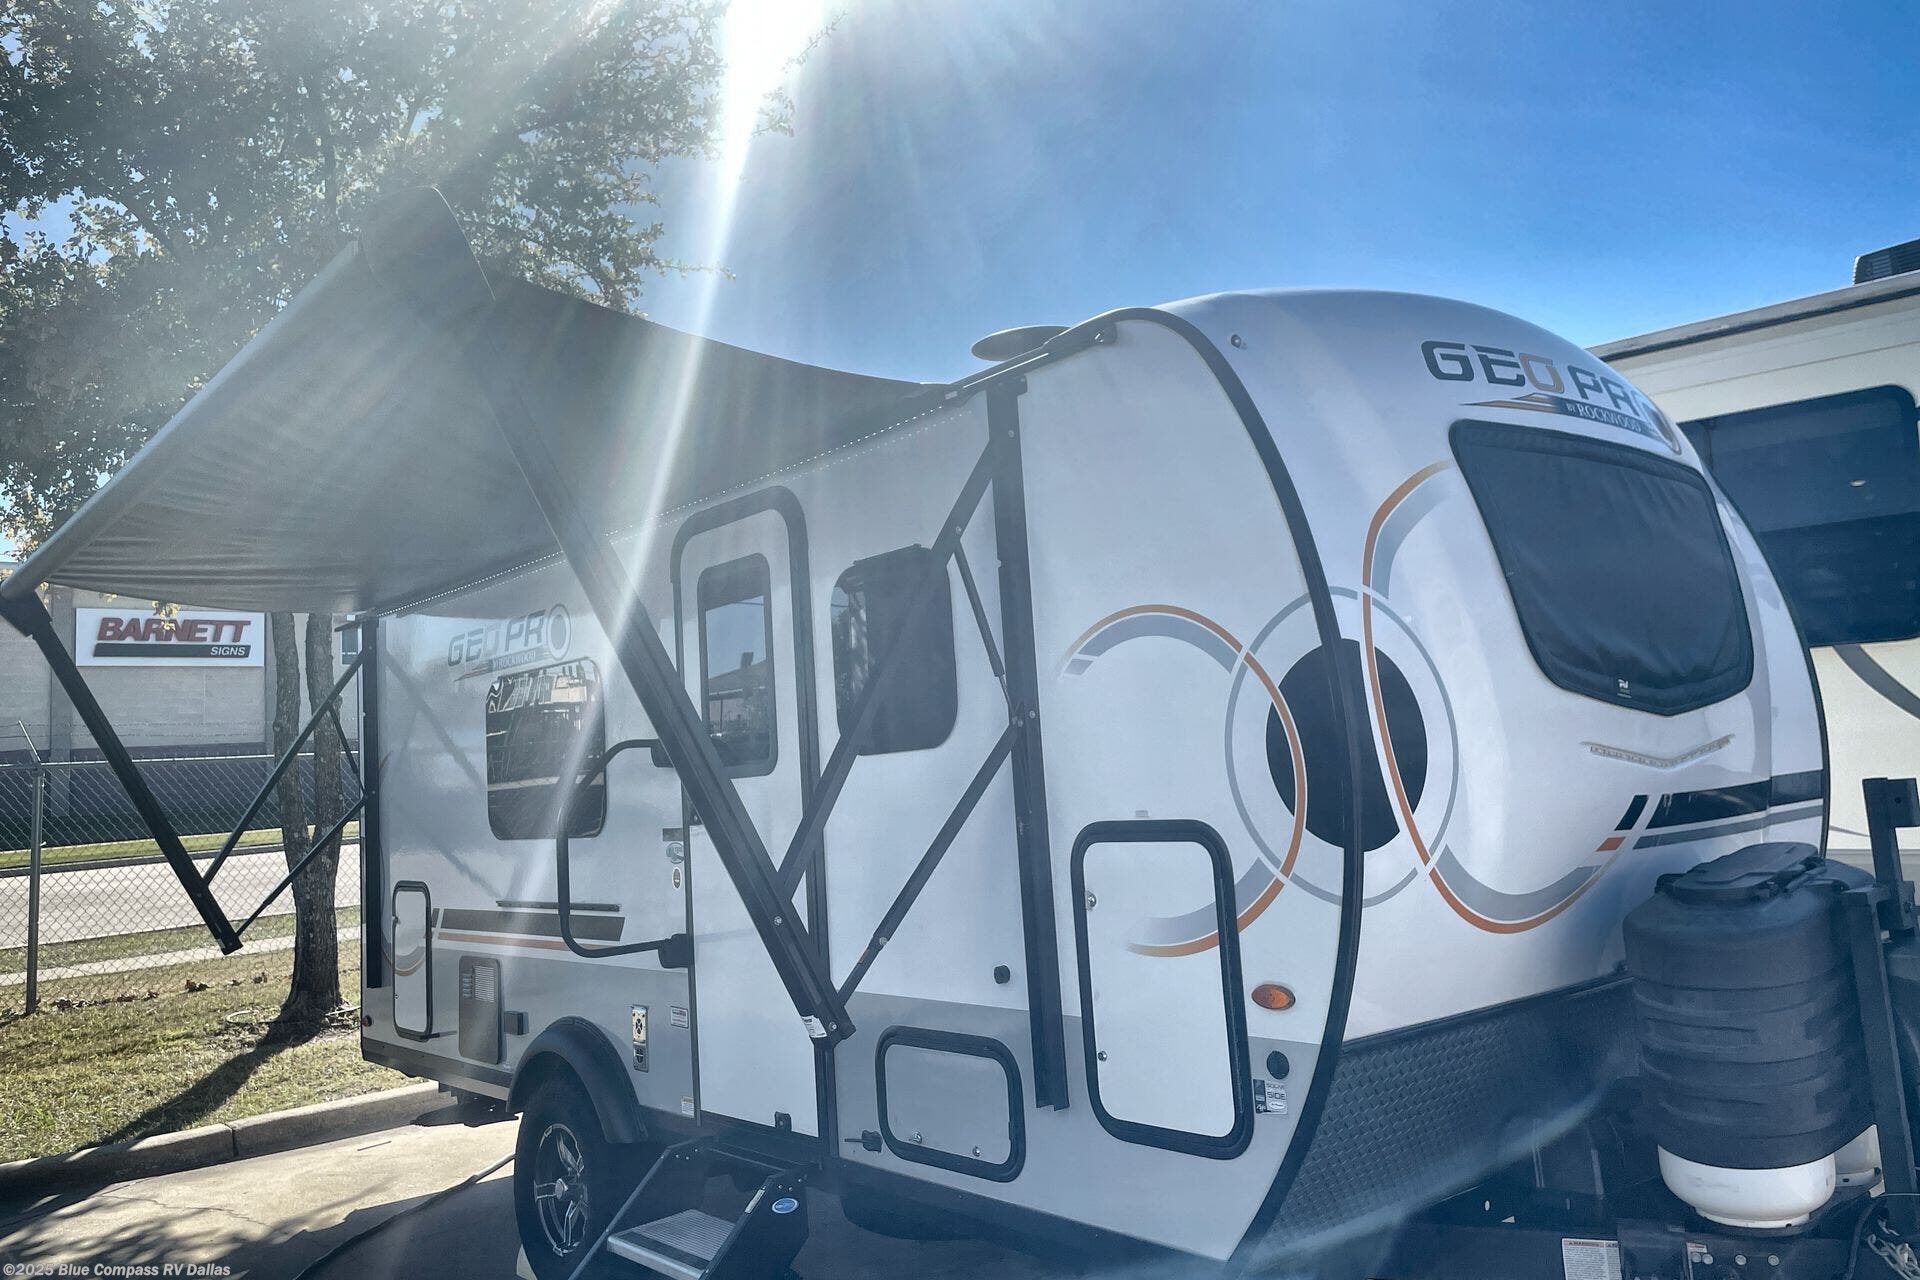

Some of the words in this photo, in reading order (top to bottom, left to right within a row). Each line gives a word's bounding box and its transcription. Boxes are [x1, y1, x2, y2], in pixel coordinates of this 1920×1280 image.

[1420, 339, 1566, 394] GEO
[96, 617, 252, 643] BARNETT
[447, 624, 501, 667] GEO
[504, 603, 571, 661] PRO
[210, 646, 246, 656] SIGNS
